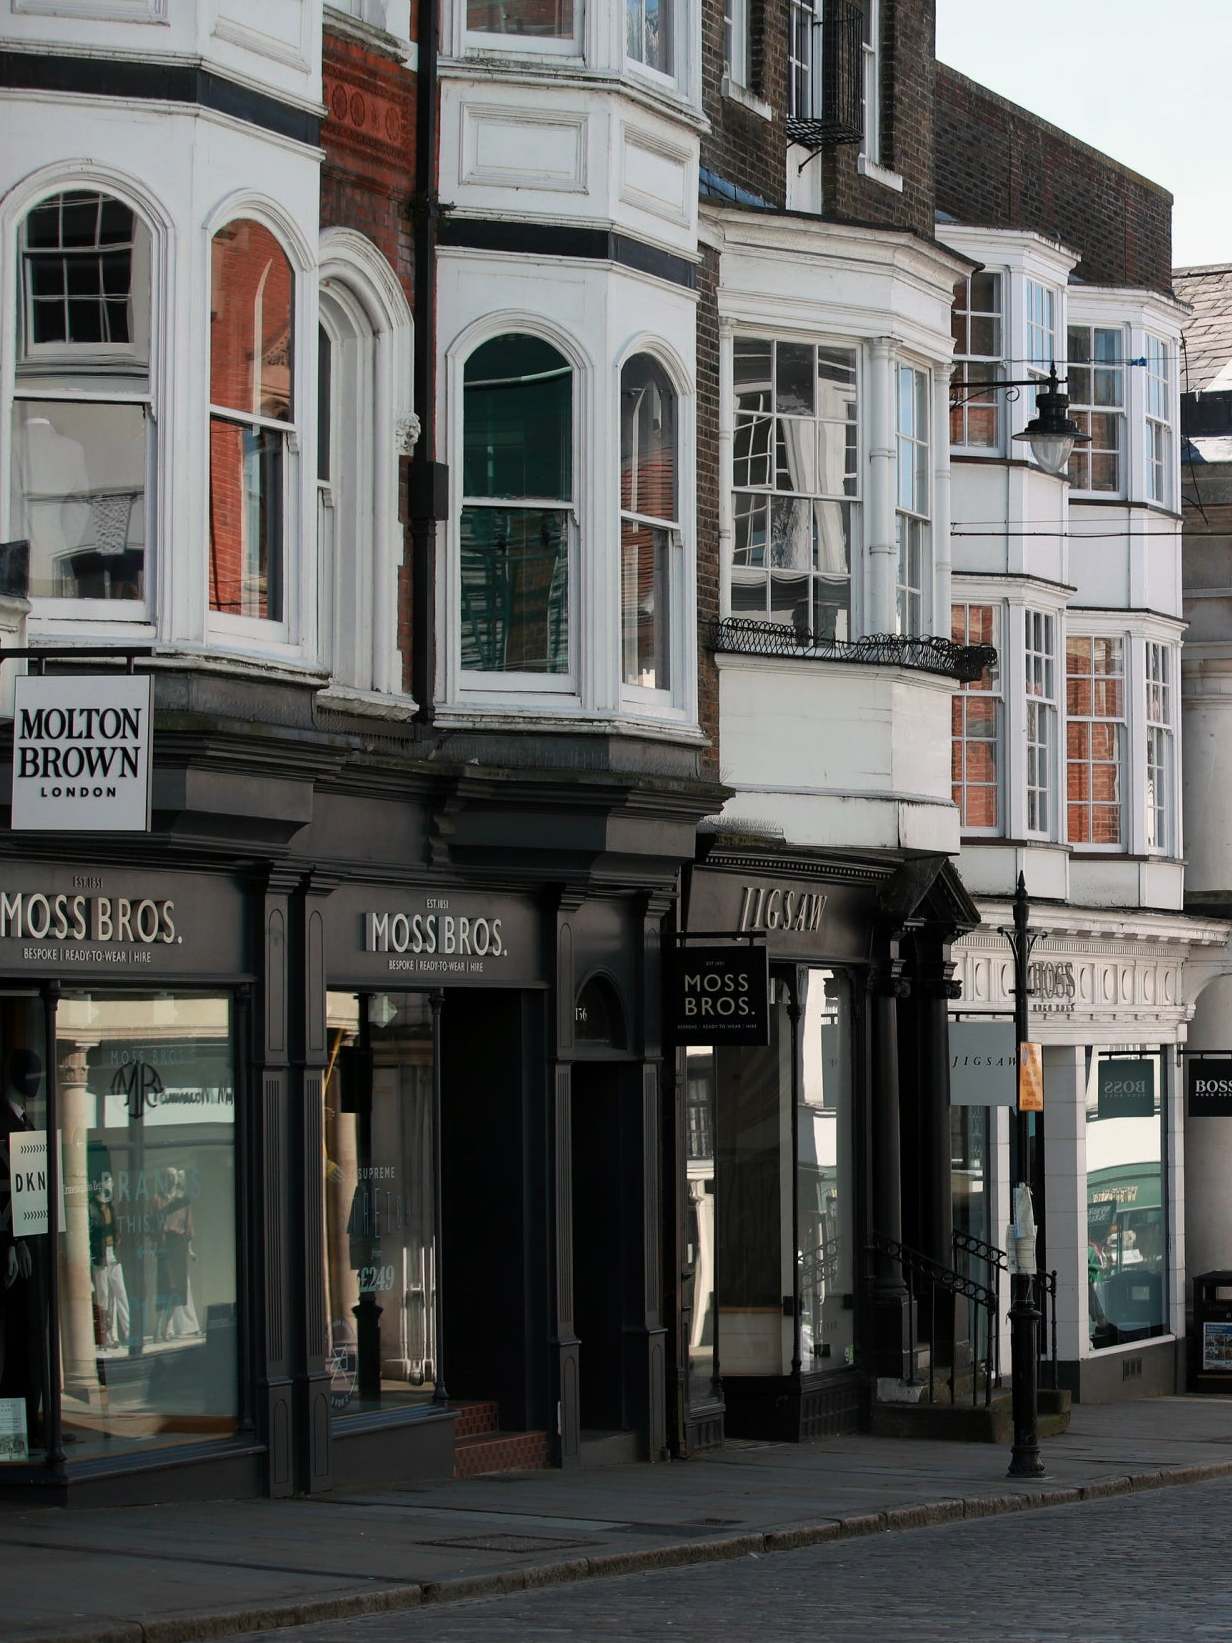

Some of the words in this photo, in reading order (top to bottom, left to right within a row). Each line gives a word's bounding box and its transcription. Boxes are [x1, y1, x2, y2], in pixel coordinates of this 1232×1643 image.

[18, 708, 142, 740] MOLTON
[17, 746, 141, 778] BROWN
[40, 787, 117, 798] LONDON
[0, 892, 87, 940] MOSS
[96, 896, 183, 944] BROS.
[738, 887, 829, 939] JIGSAW
[372, 912, 437, 954] MOSS
[444, 915, 509, 957] BROS.
[23, 947, 58, 961] BESPOKE
[64, 949, 127, 963] READY-TO-WEAR
[133, 951, 152, 964] HIRE
[388, 959, 415, 971] BESPOKE
[419, 960, 465, 972] READY-TO-WEAR
[470, 962, 484, 973] HIRE
[684, 974, 748, 992] MOSS
[684, 997, 756, 1016] BROS.
[952, 1056, 1016, 1068] JIGSAW
[16, 1171, 47, 1192] DKN
[357, 1167, 397, 1181] SUPREME
[360, 1264, 395, 1292] £249
